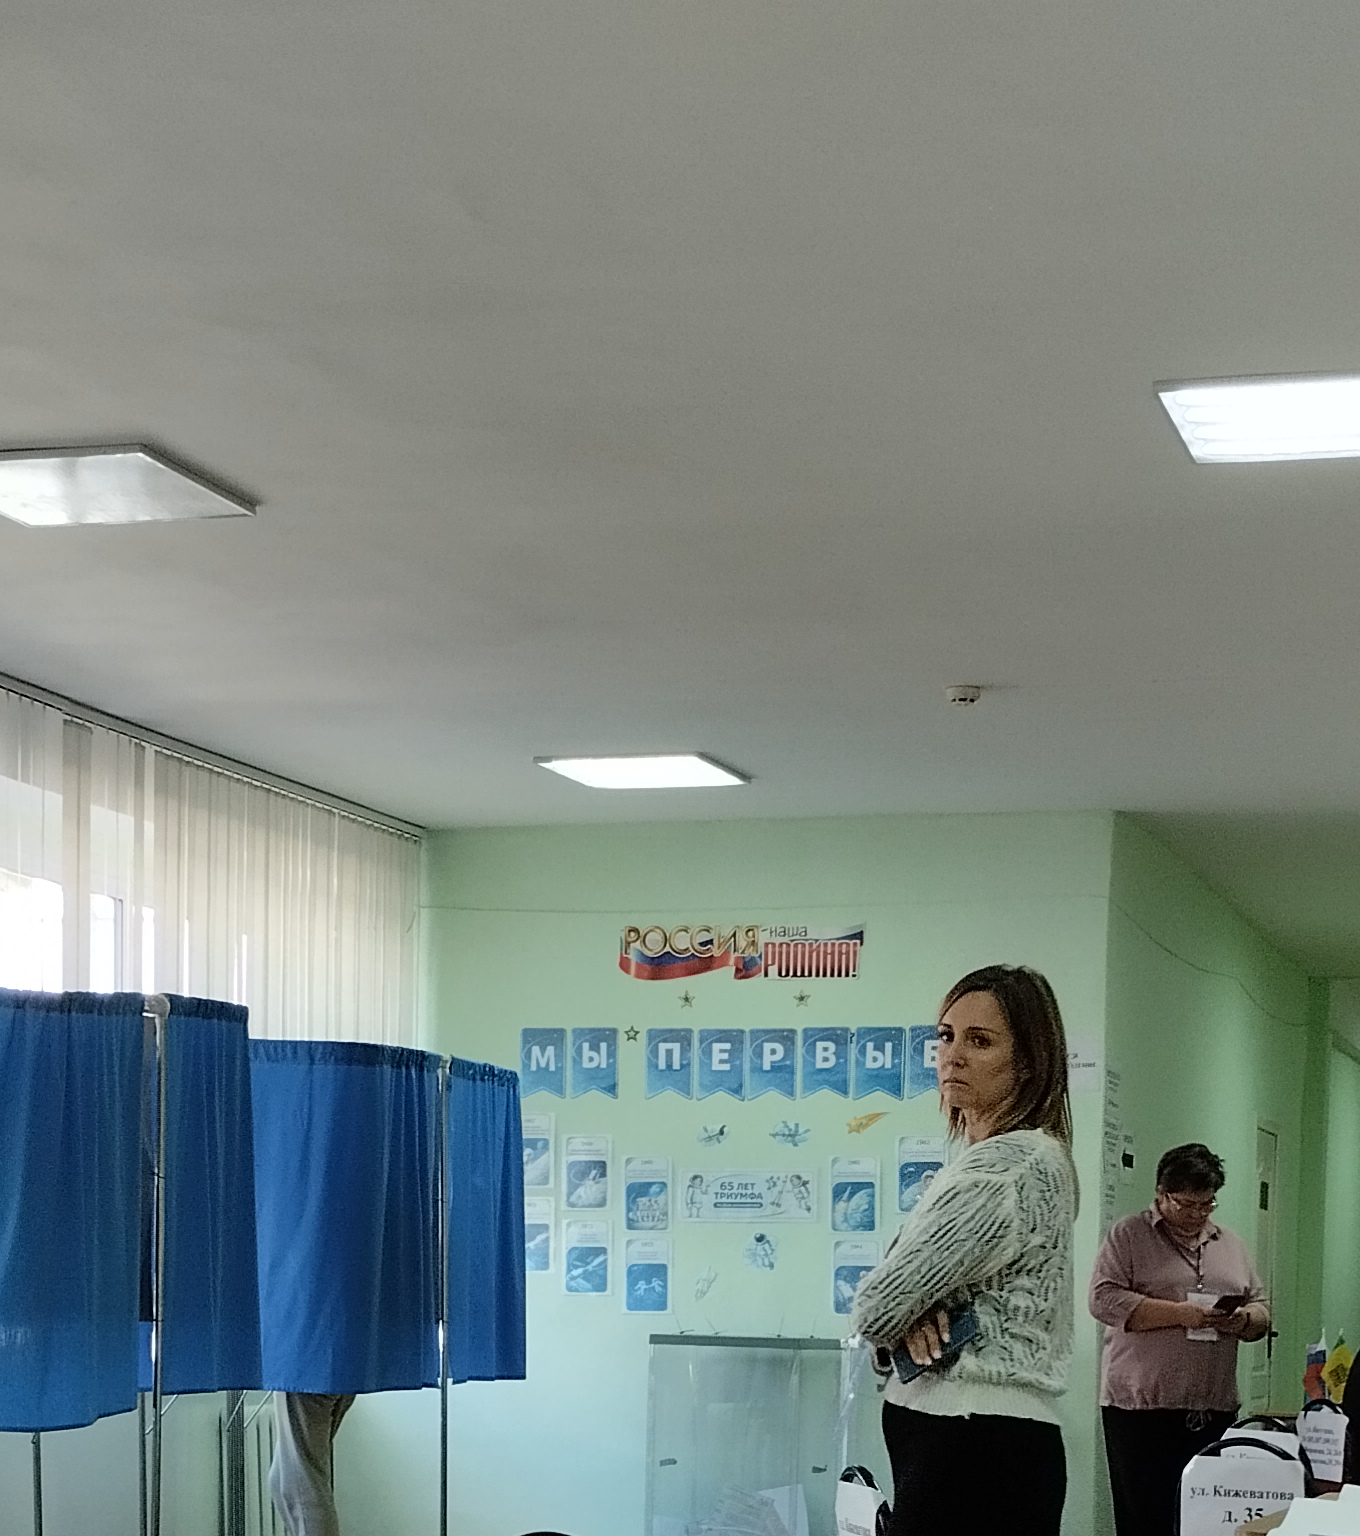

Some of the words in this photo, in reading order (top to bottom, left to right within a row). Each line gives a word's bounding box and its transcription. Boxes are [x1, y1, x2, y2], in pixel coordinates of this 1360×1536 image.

[624, 925, 760, 957] РОССИЯ
[763, 940, 860, 978] РОДИНА!
[530, 1042, 608, 1072] МЫ
[713, 1191, 763, 1201] ТРИУМФА
[719, 1181, 734, 1191] 65
[736, 1182, 756, 1191] ЛЕТ
[1190, 1486, 1209, 1499] ул.
[1213, 1485, 1294, 1501] Кижеватова
